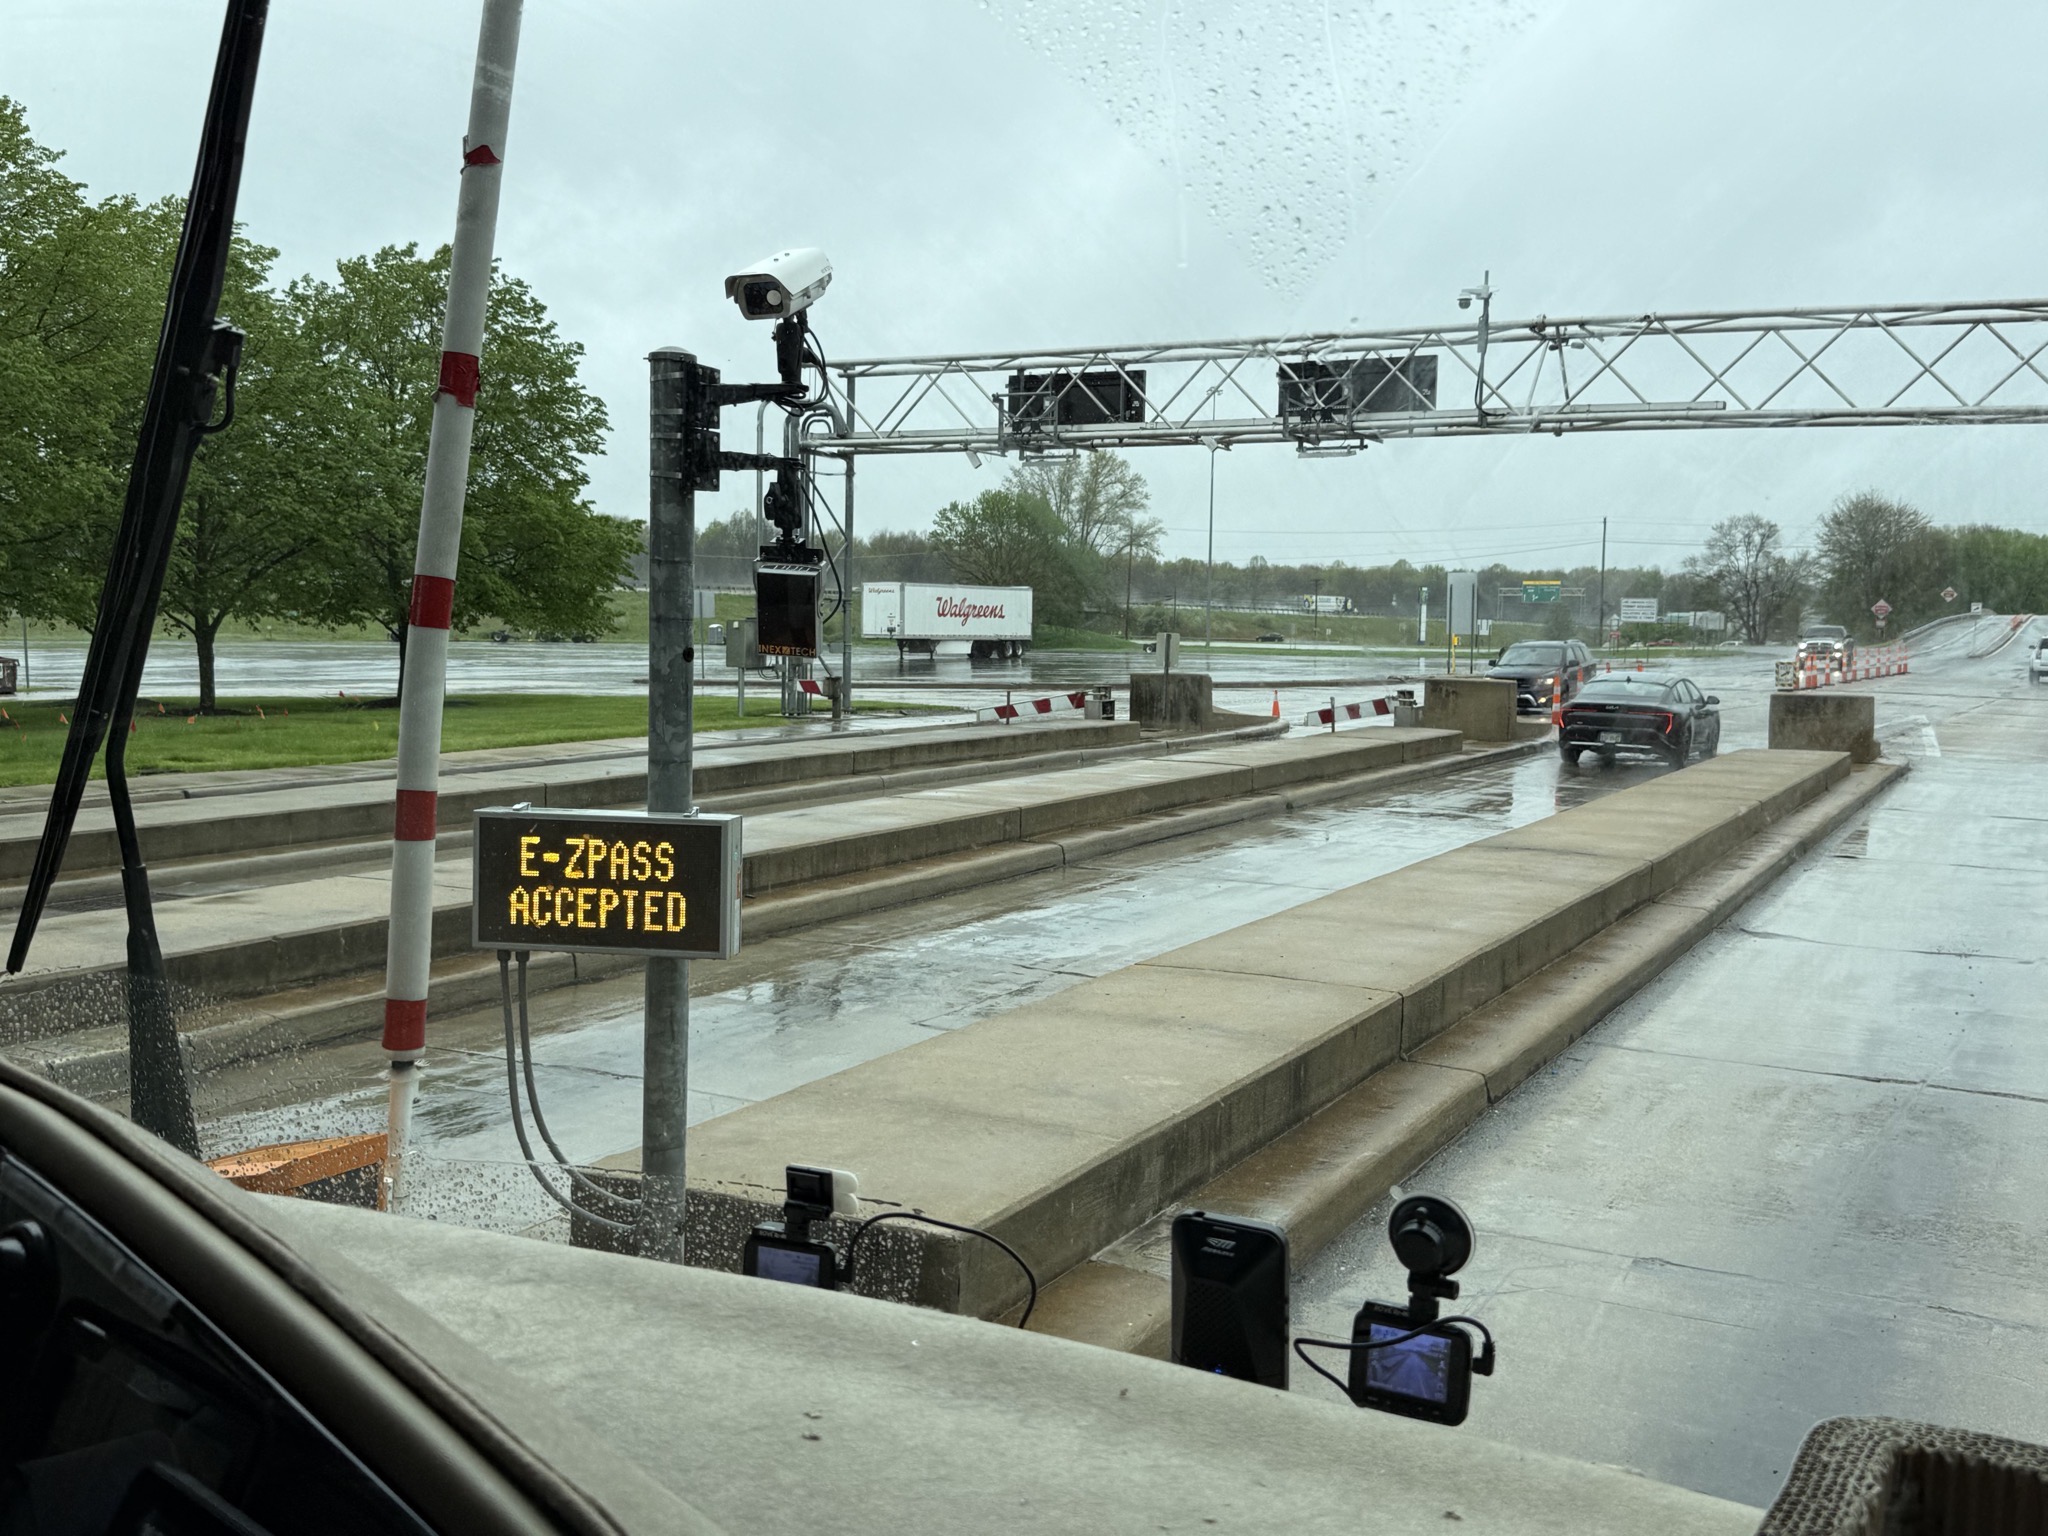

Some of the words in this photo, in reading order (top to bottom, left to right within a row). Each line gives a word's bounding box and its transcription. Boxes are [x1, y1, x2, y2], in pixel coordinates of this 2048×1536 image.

[936, 597, 1006, 626] Walgreens
[758, 644, 782, 654] INEX
[790, 646, 816, 657] TECH
[520, 836, 674, 882] E-ZPASS
[509, 885, 687, 932] ACCEPTED
